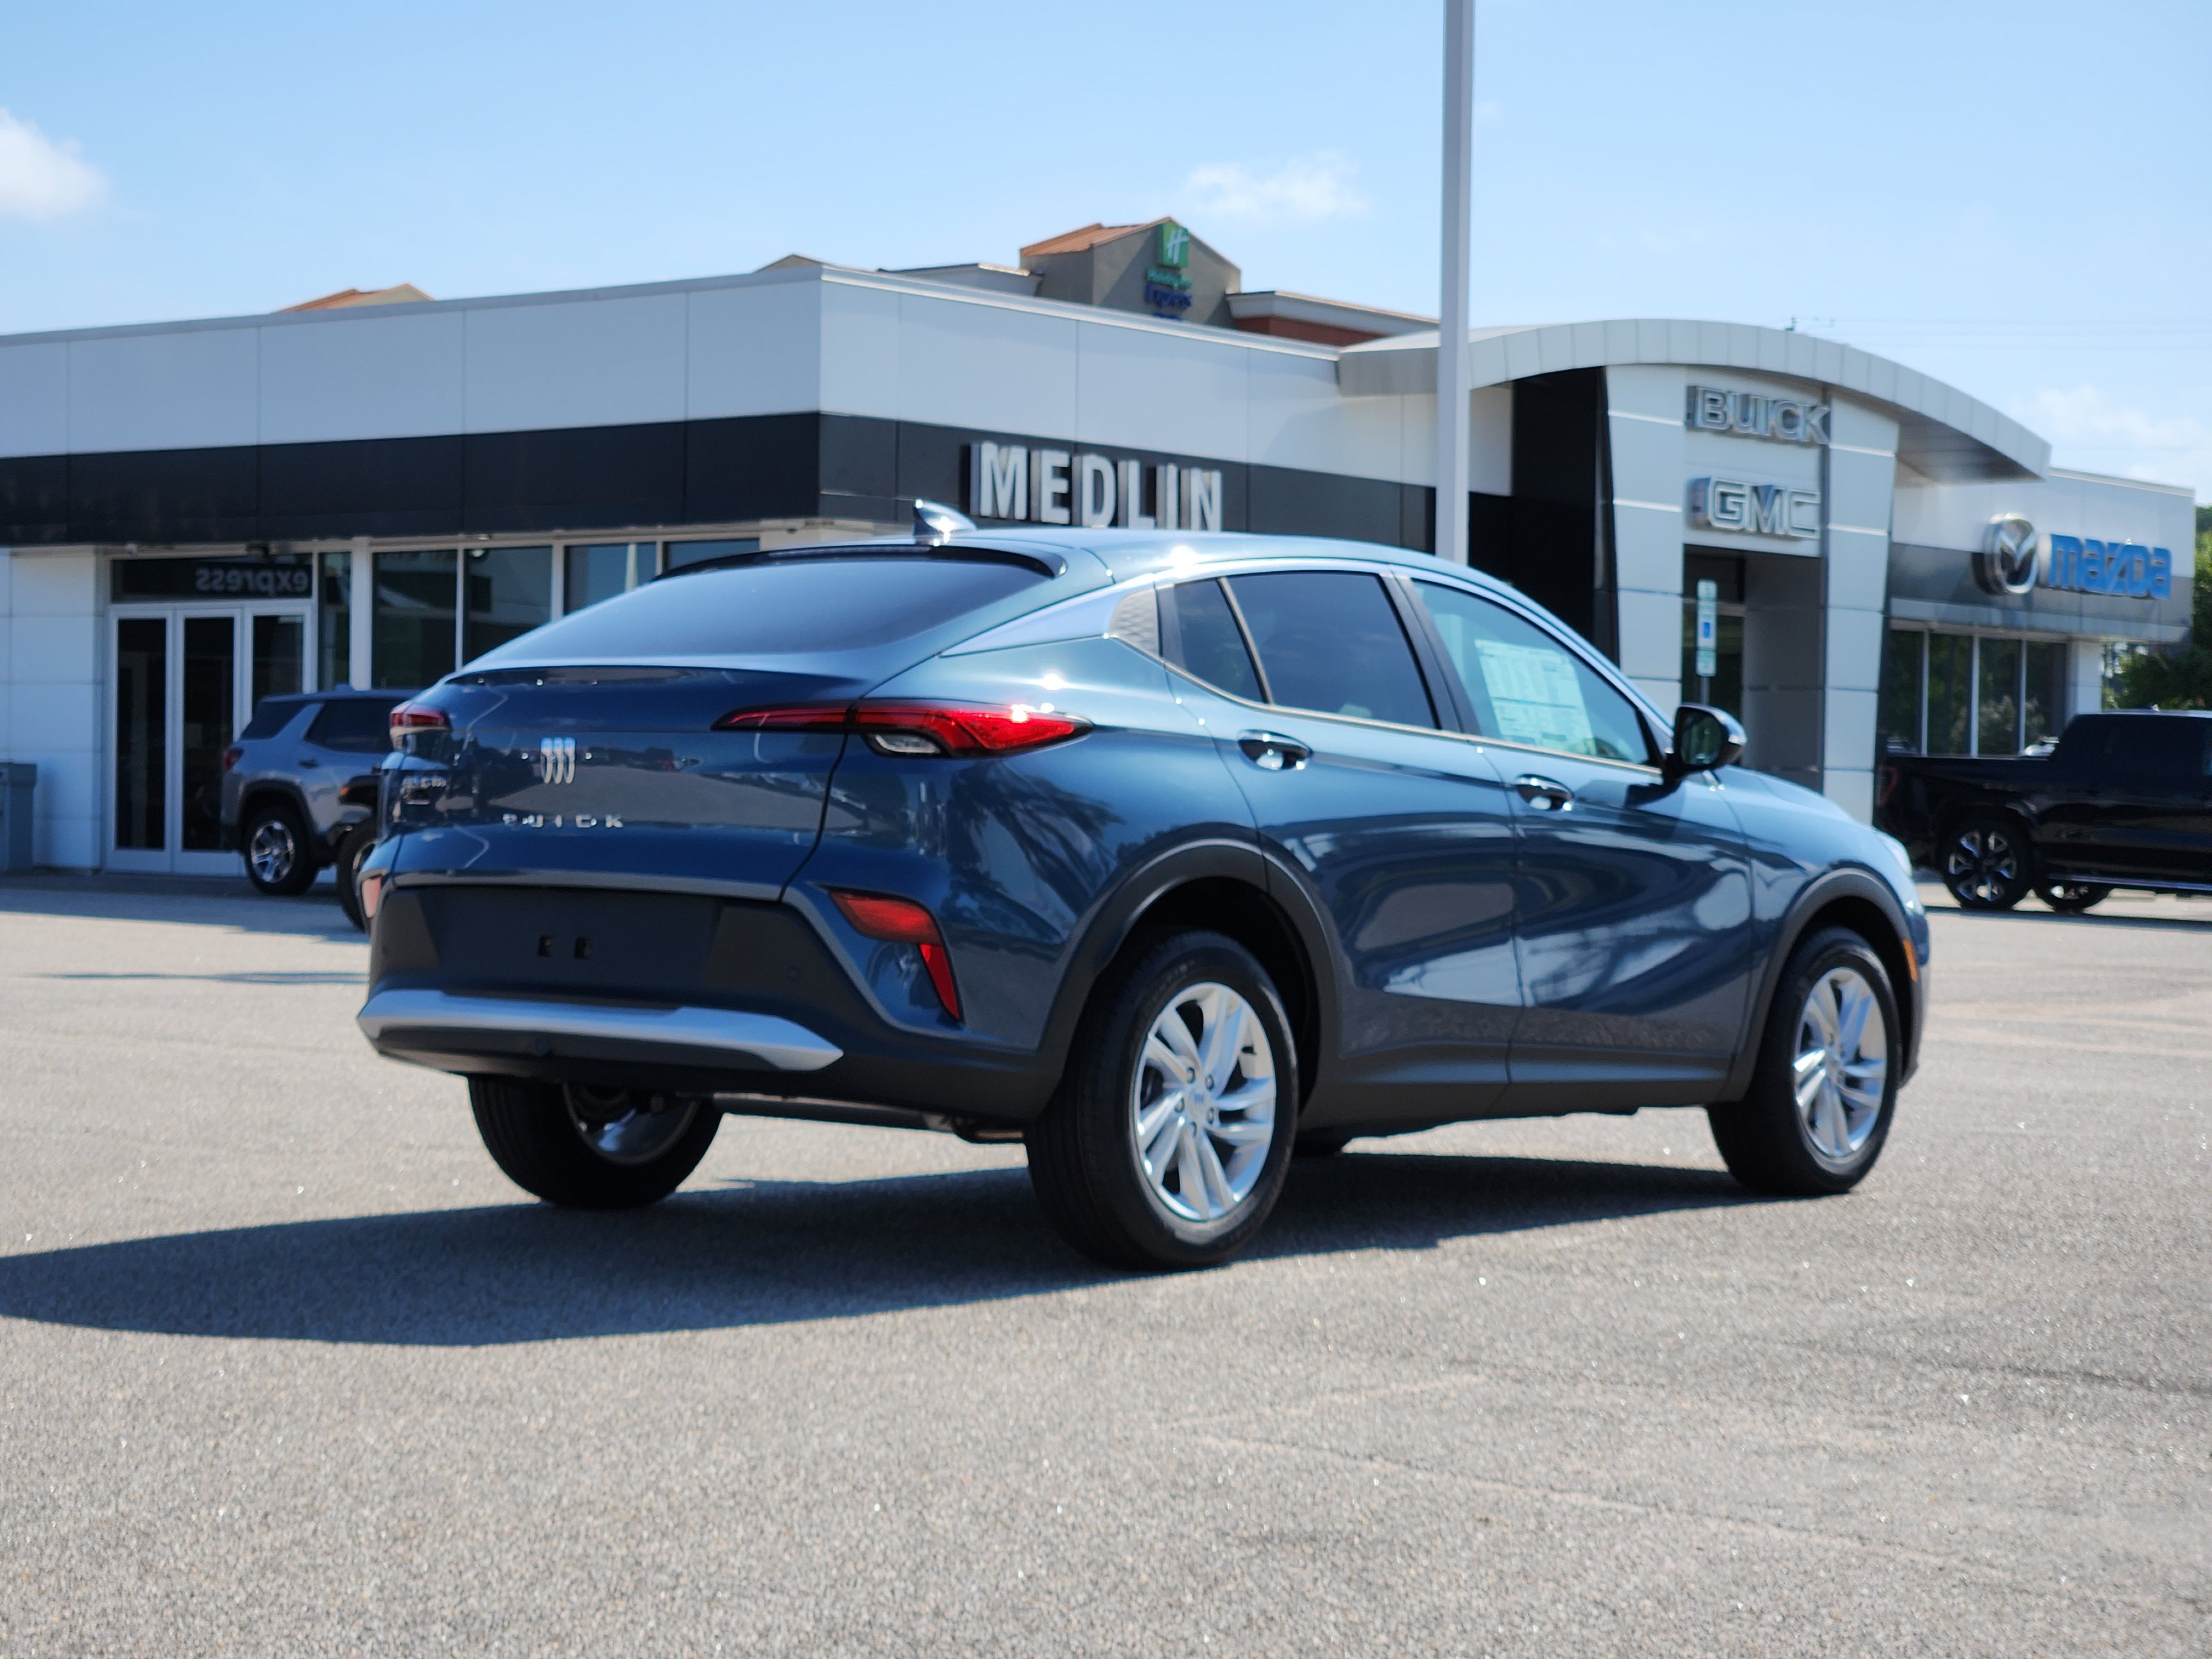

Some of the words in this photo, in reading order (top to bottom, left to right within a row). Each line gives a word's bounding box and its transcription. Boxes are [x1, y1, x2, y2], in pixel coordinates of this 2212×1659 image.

[1695, 387, 1829, 444] BUICK
[971, 441, 1223, 532] MEDLIN
[1708, 478, 1819, 539] GMC
[2048, 534, 2172, 599] mazda
